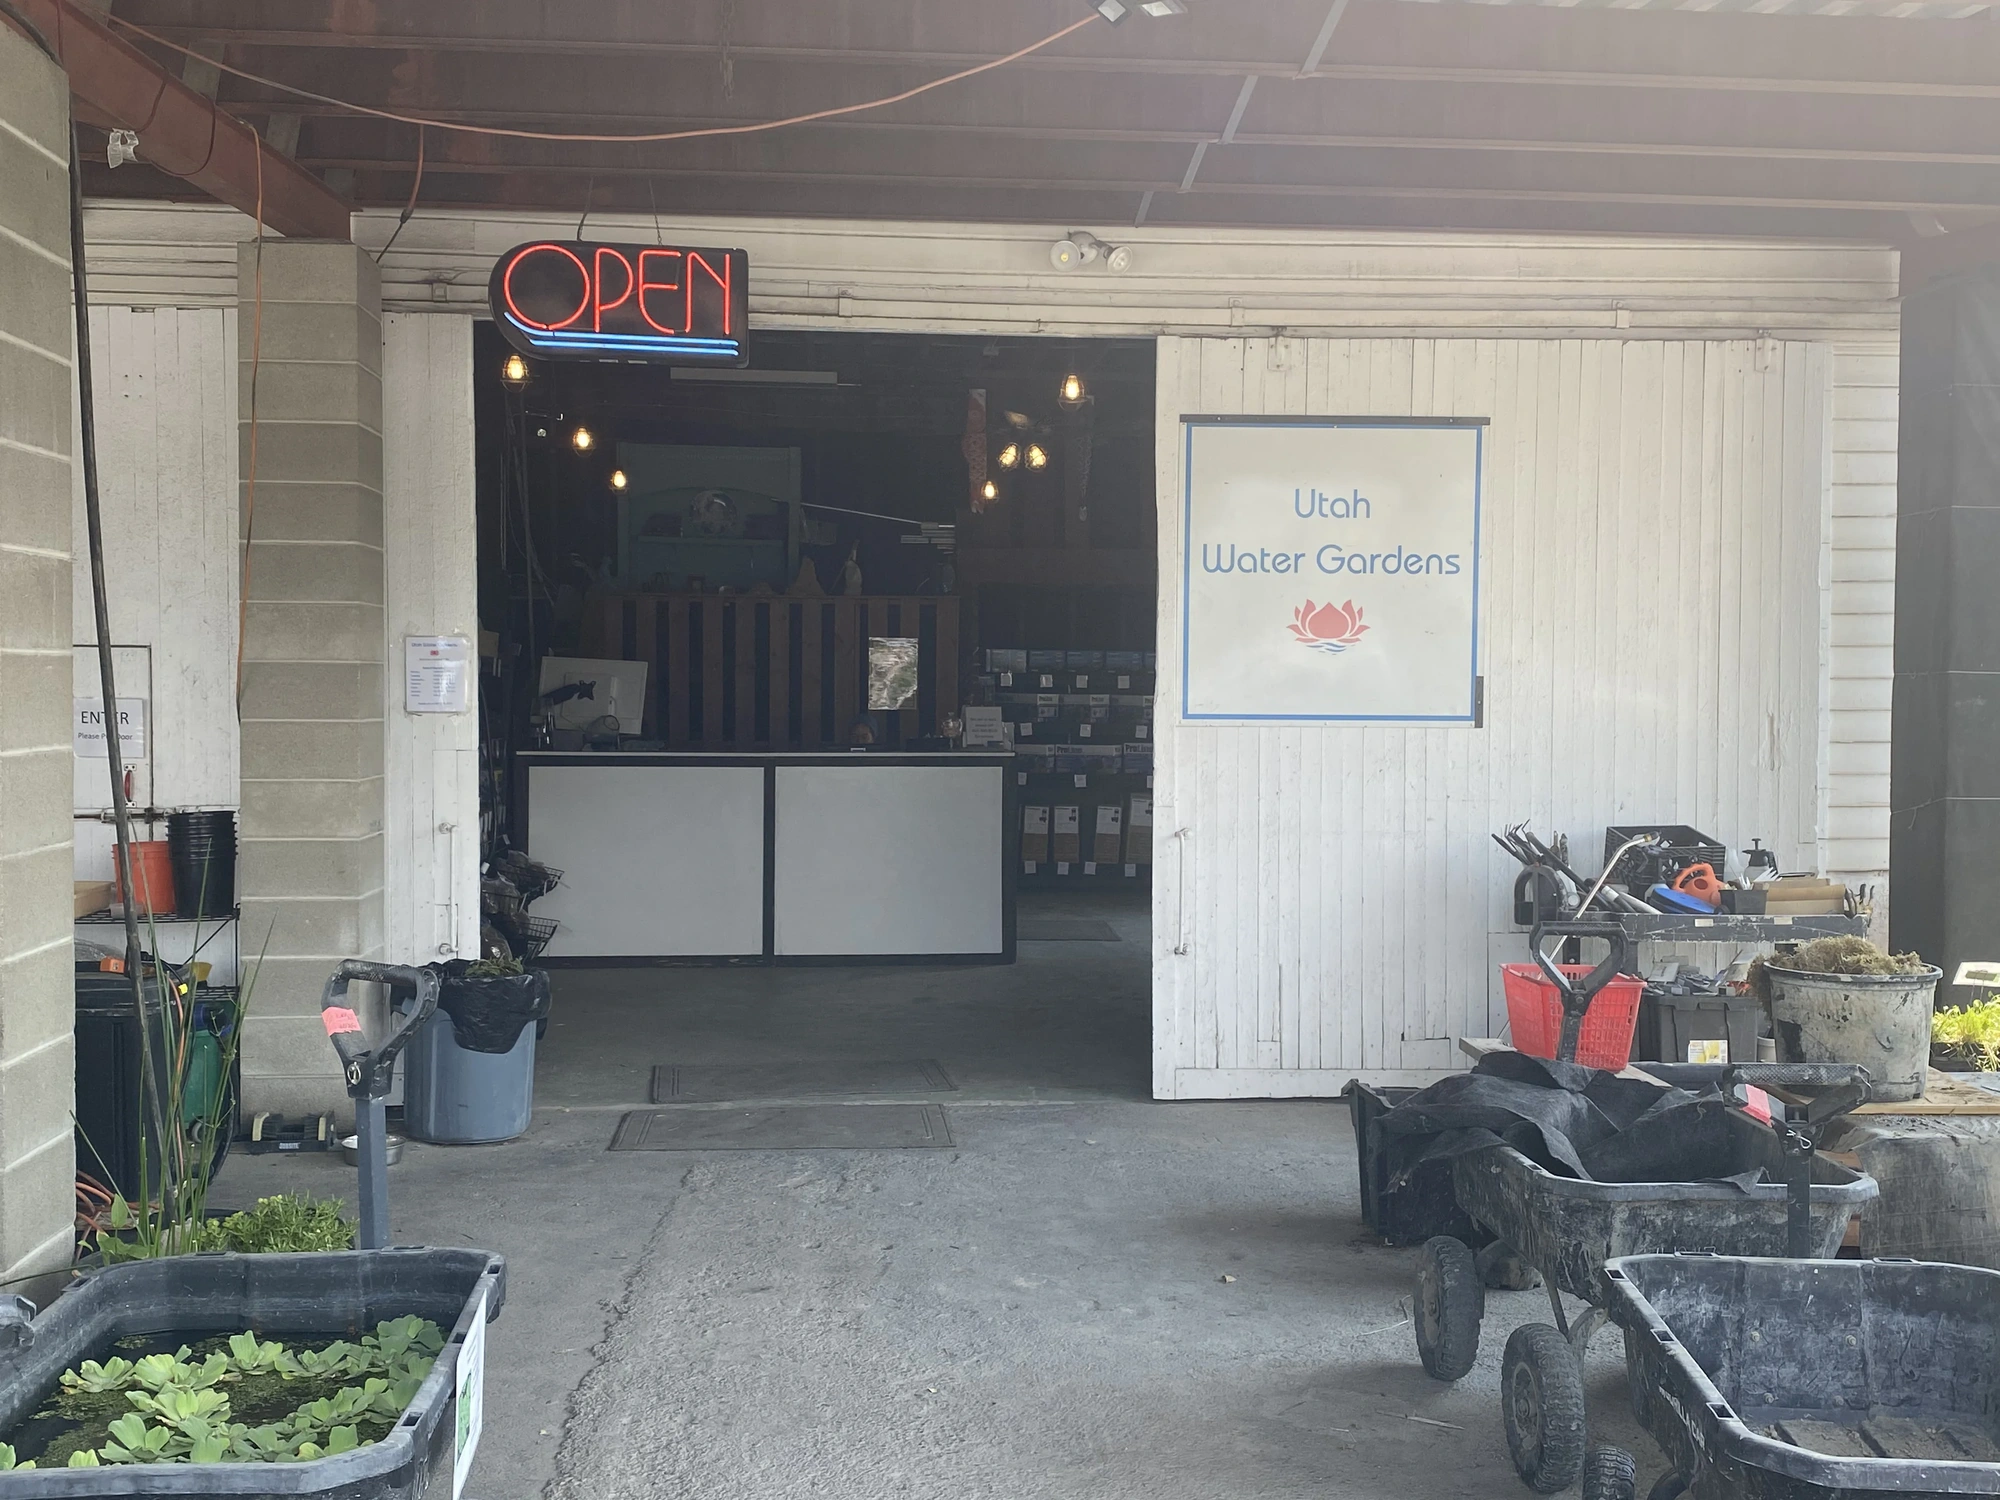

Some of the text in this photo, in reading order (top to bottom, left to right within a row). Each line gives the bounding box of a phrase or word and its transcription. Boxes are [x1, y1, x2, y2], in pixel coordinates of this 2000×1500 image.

[503, 244, 731, 335] OPEN
[1294, 488, 1371, 519] Utah
[1202, 543, 1461, 575] Water Gardens
[78, 732, 100, 740] Please
